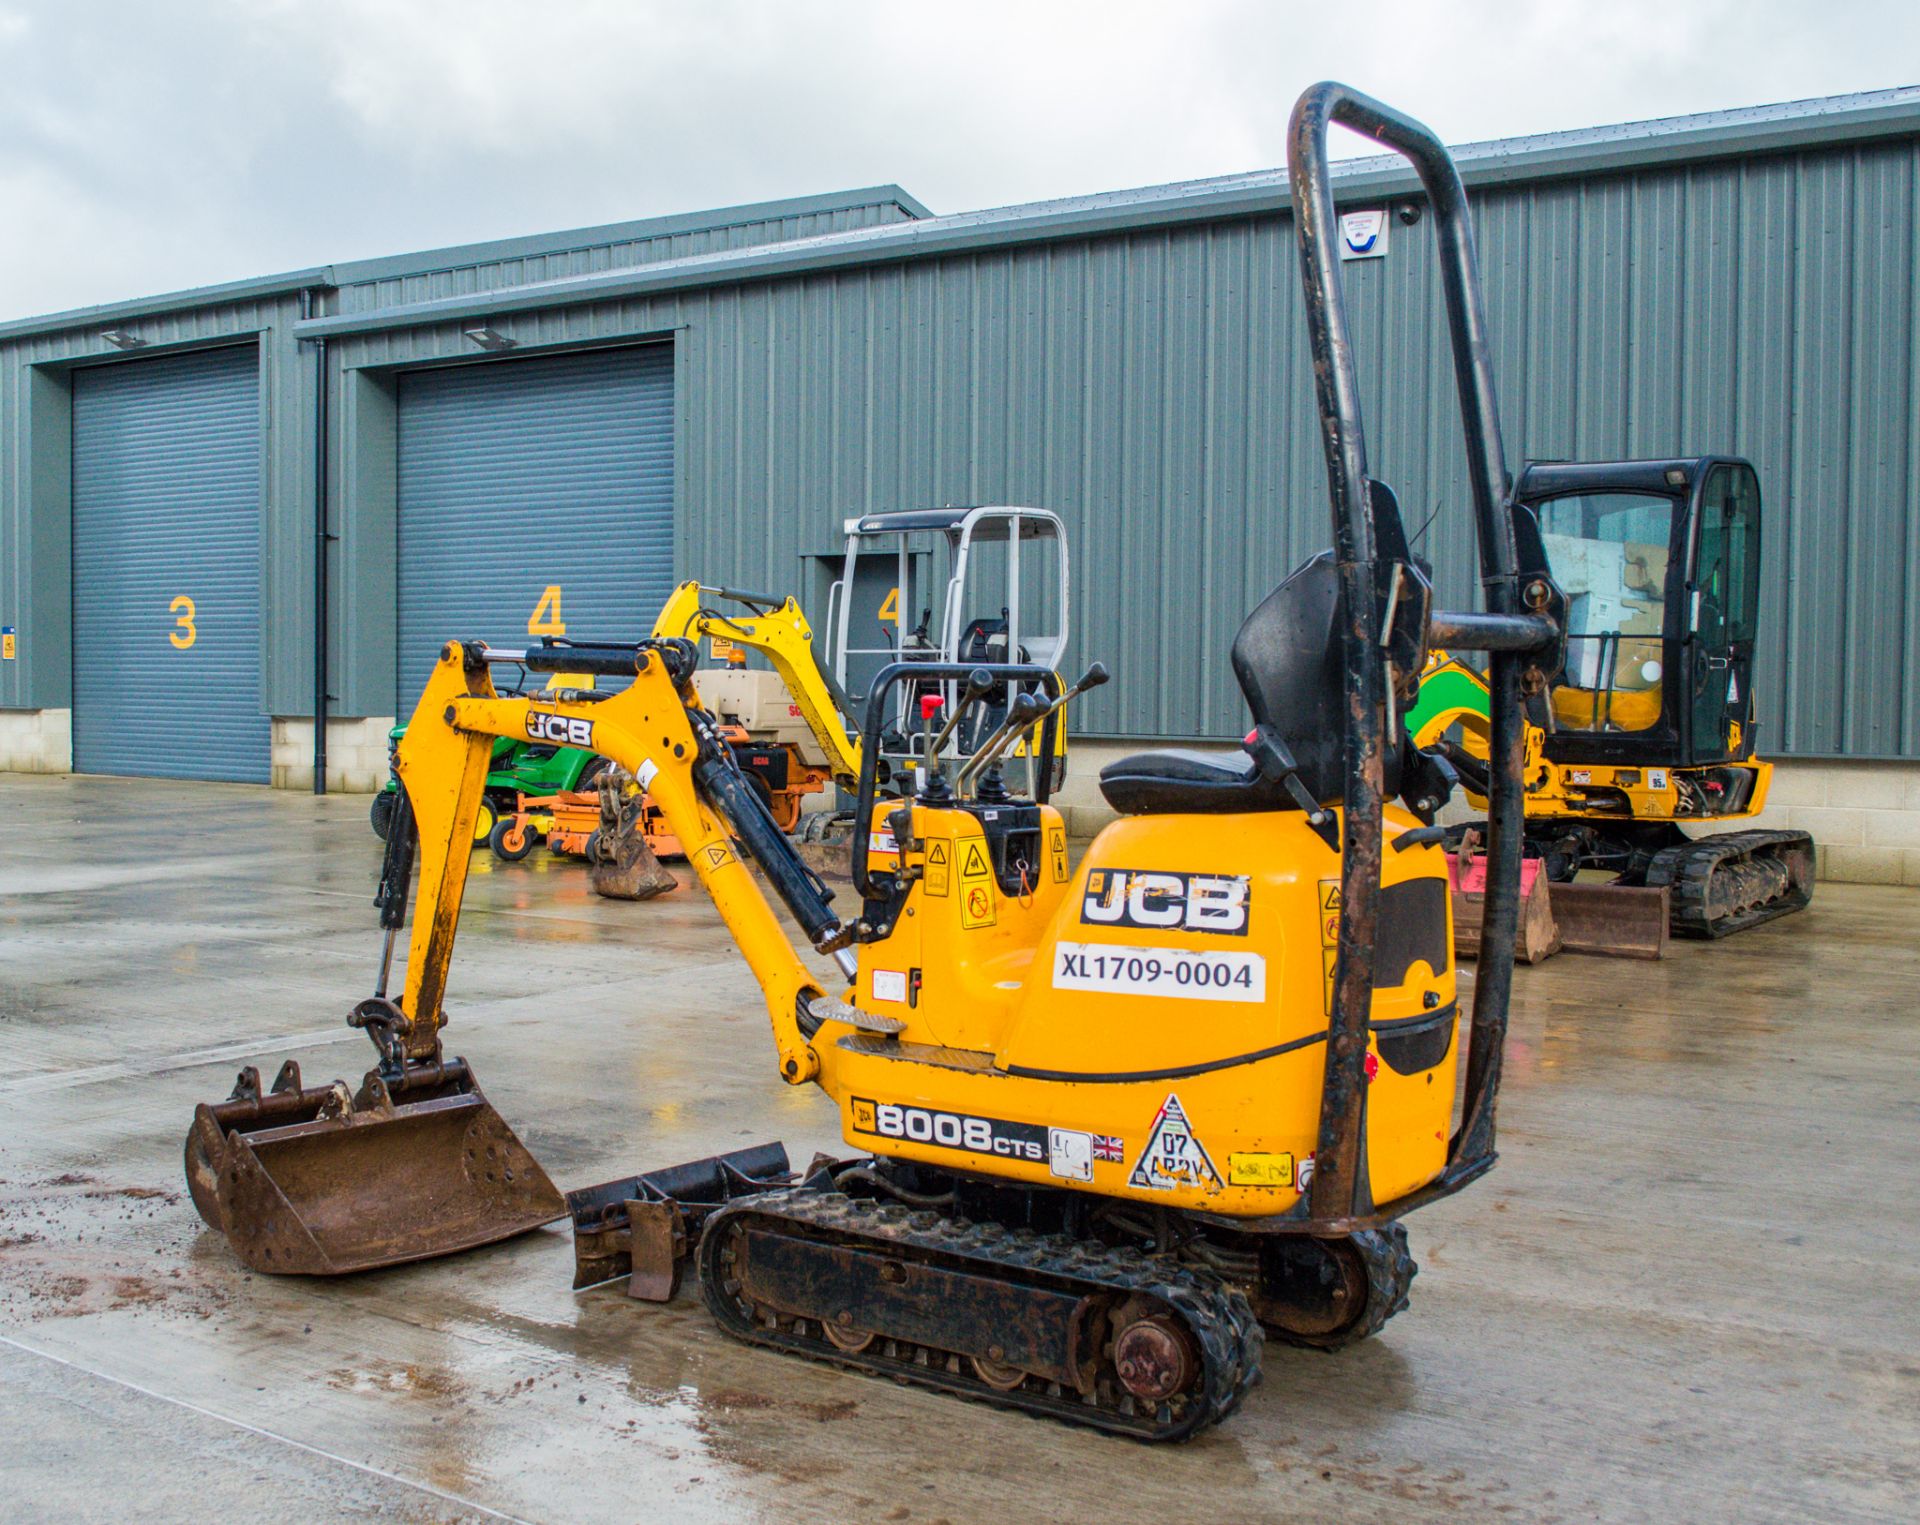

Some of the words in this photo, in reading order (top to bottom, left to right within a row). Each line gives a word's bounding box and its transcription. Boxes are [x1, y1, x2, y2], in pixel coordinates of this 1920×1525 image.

[169, 596, 196, 649] 3
[528, 585, 566, 647] 4
[878, 587, 899, 627] 4
[527, 714, 592, 746] JCB
[789, 705, 801, 717] SC
[1084, 872, 1246, 931] JCB
[1061, 953, 1253, 989] XL1709-0004
[877, 1104, 993, 1152] 8008
[993, 1136, 1043, 1160] CTS
[1162, 1132, 1187, 1155] 07
